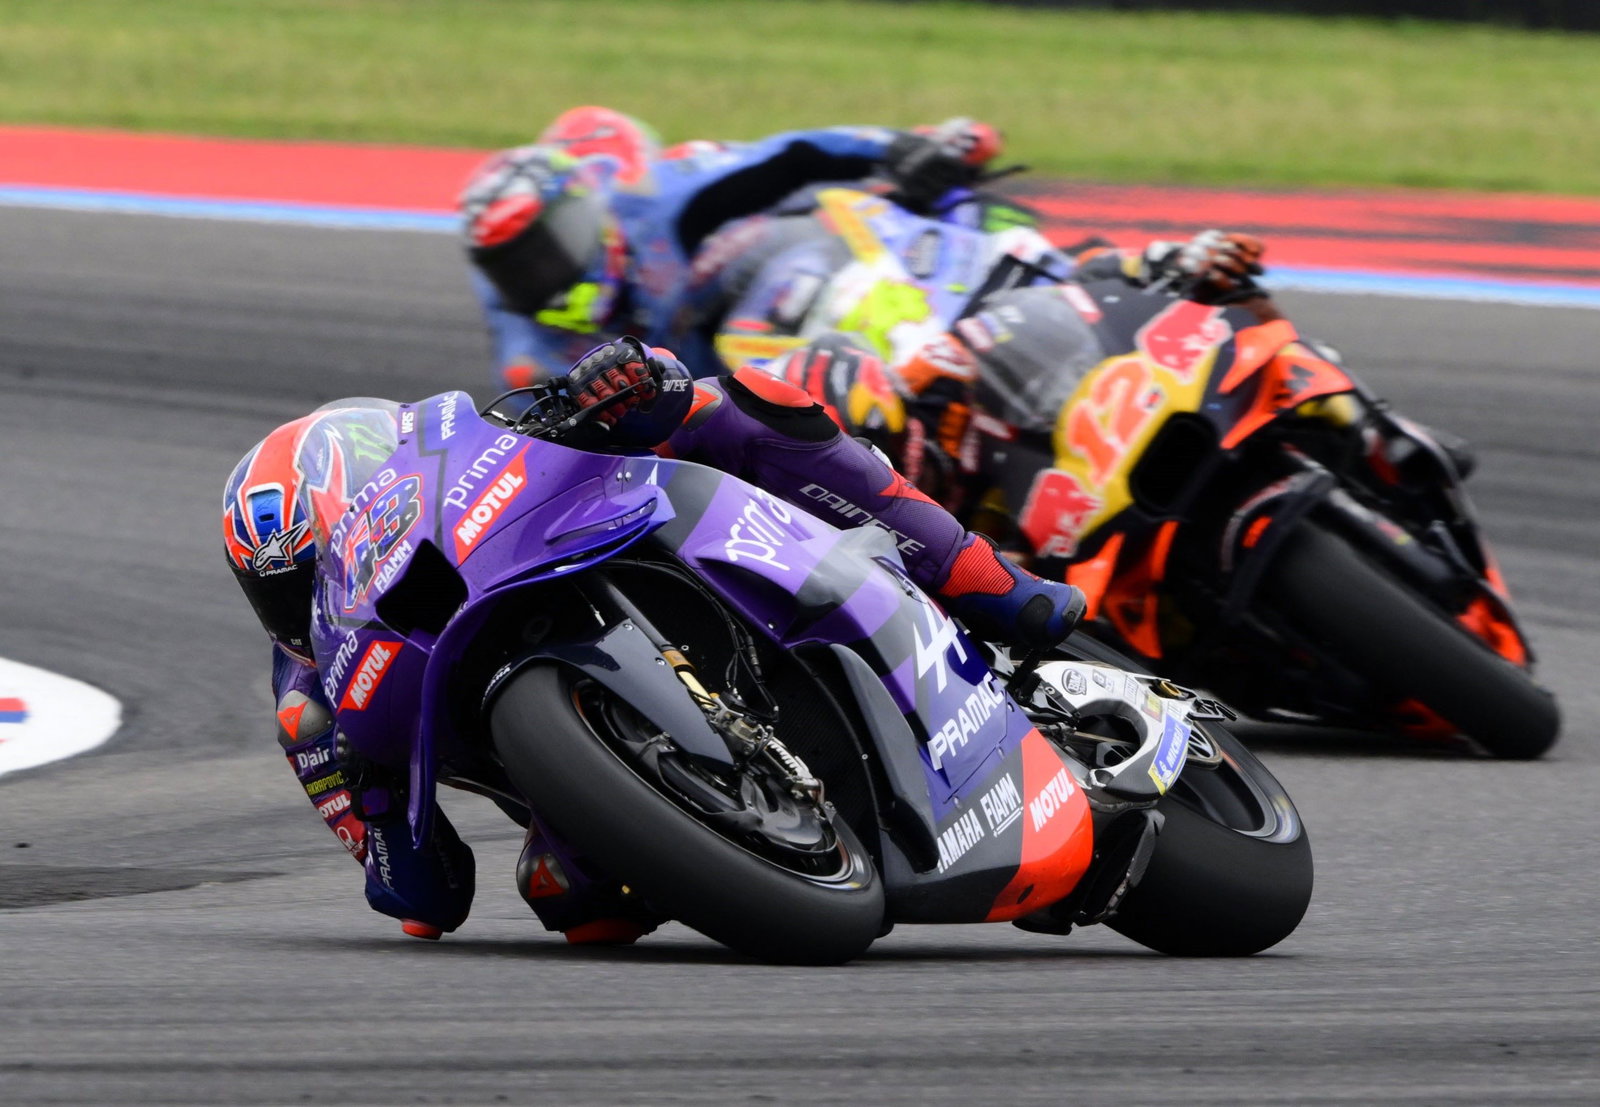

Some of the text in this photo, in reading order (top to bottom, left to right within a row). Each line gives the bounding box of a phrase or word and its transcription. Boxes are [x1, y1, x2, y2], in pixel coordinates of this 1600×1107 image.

[401, 411, 414, 434] WRS
[1066, 357, 1152, 485] 12
[443, 434, 518, 510] prima
[331, 468, 397, 558] prima
[456, 471, 524, 546] MOTUL
[724, 487, 791, 571] prima
[266, 564, 298, 577] PRAMAC
[374, 539, 414, 594] FIAMM
[324, 630, 358, 709] prima
[350, 642, 391, 709] MOTUL
[927, 671, 1004, 771] PRAMAC
[318, 794, 351, 818] OTUL
[980, 772, 1022, 830] FIAMM
[1029, 767, 1075, 832] MOTUL
